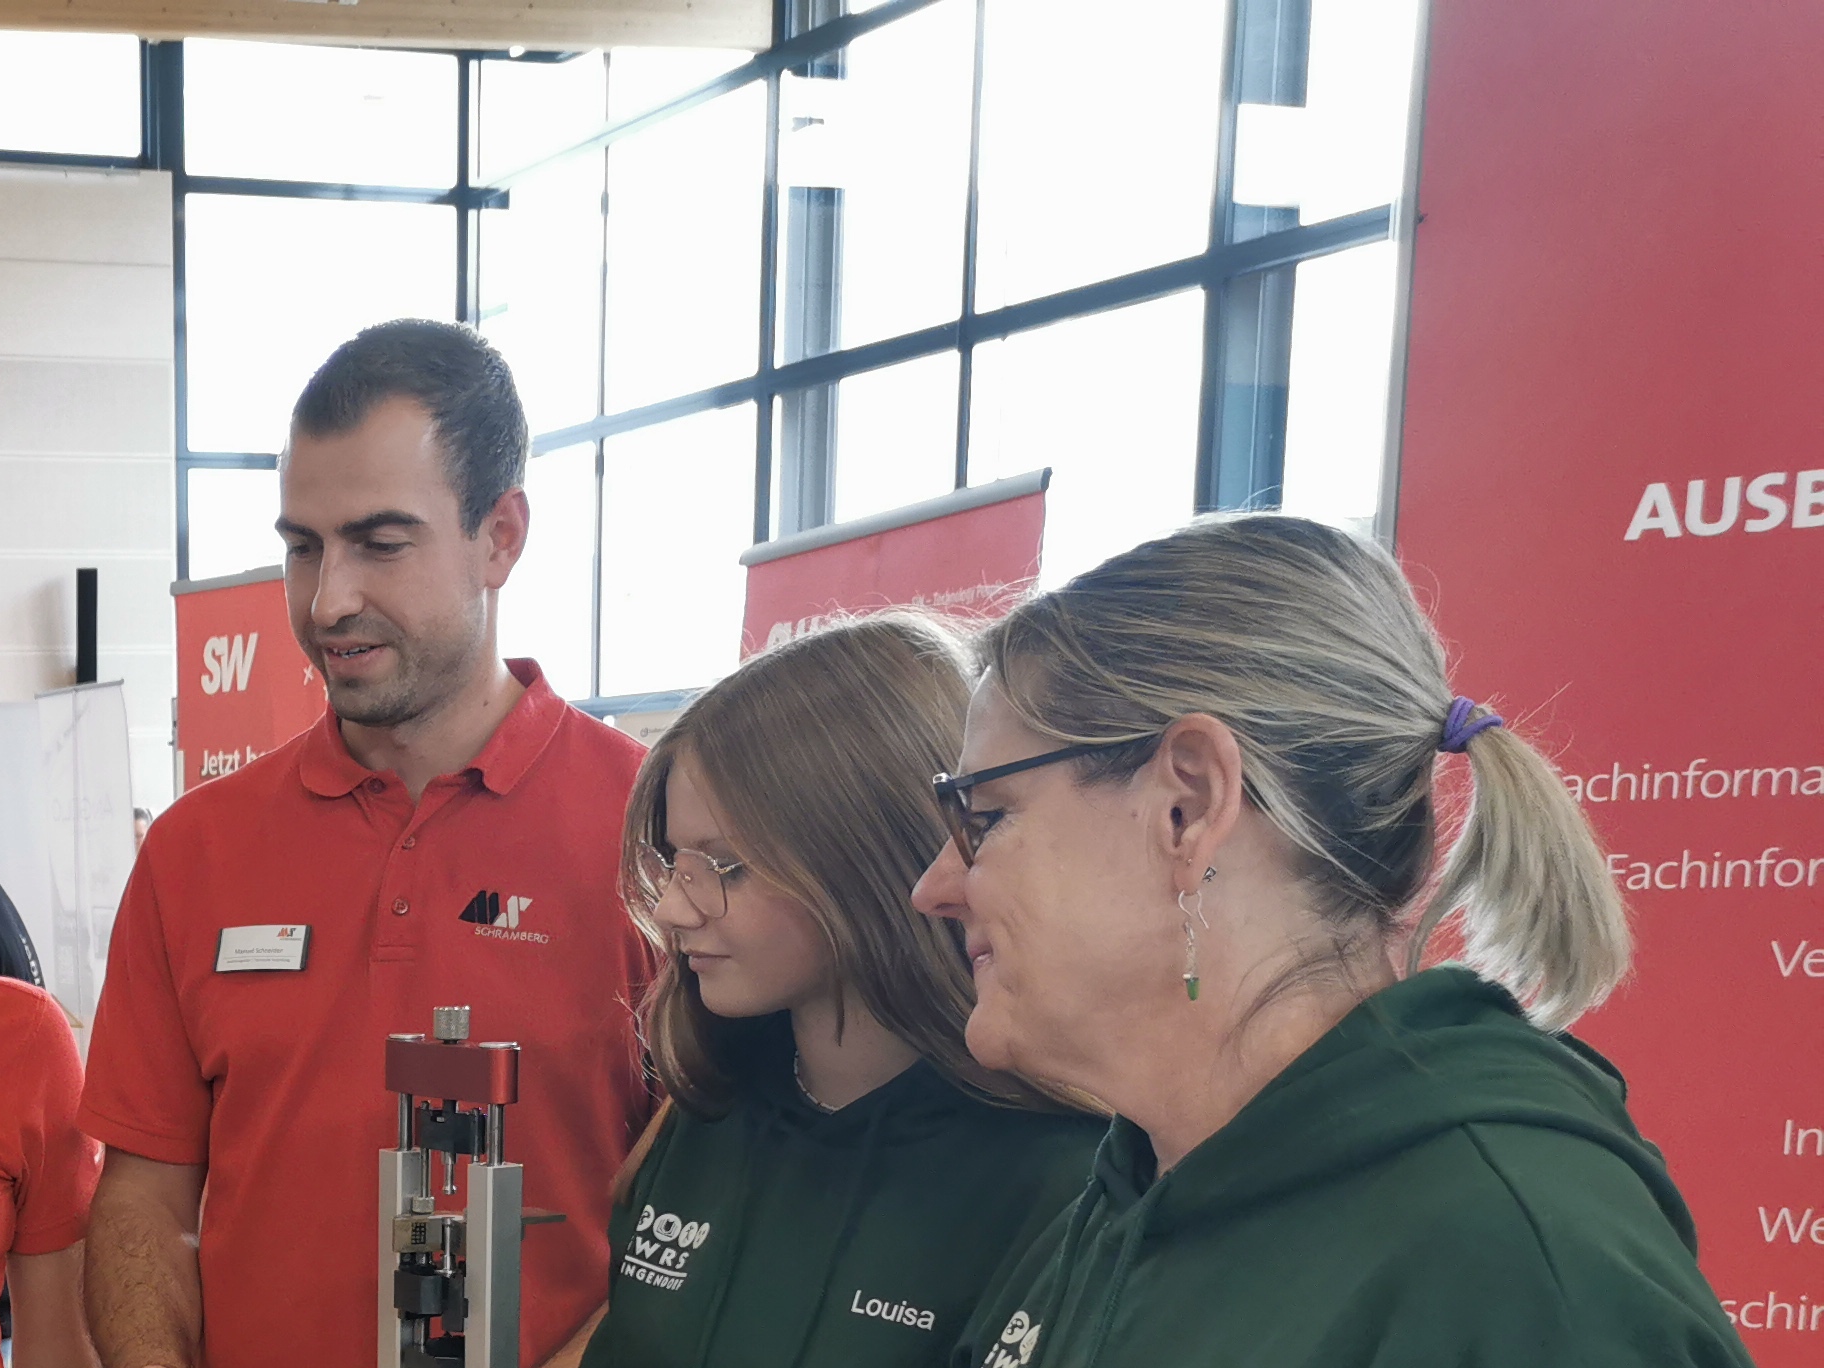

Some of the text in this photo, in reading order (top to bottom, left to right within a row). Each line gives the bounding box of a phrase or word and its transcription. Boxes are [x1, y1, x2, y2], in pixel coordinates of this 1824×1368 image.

[201, 632, 258, 695] SW
[201, 749, 240, 776] Jetzt
[1551, 758, 1824, 803] achinforma
[474, 926, 550, 944] SCHRAMBERG
[627, 1235, 690, 1269] WRS
[850, 1289, 935, 1331] Louisa
